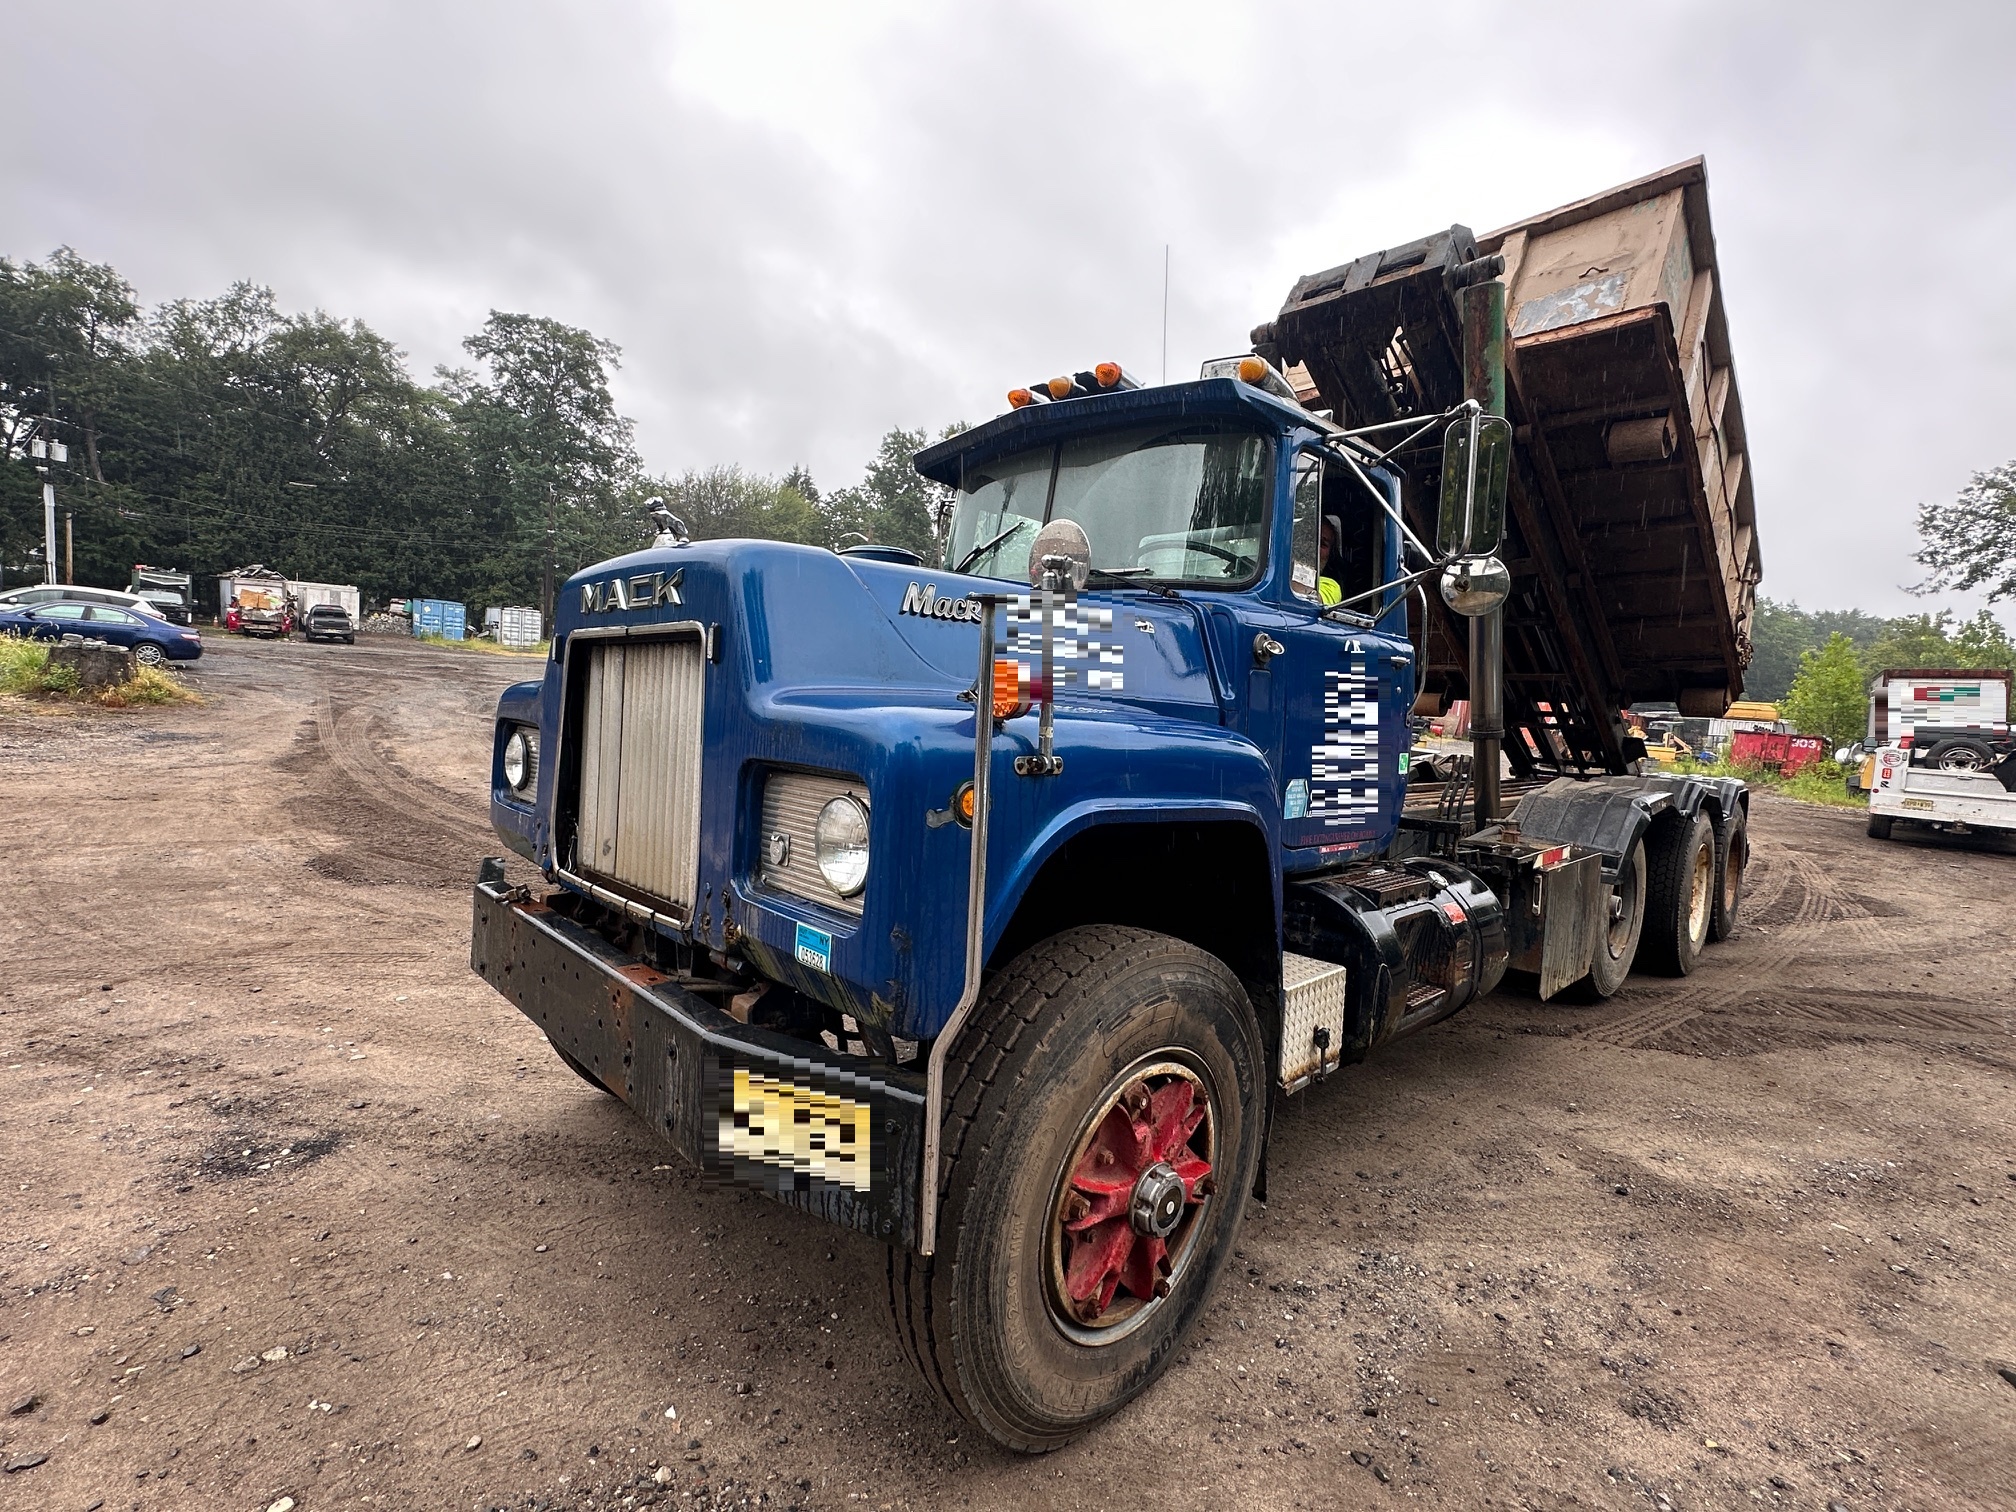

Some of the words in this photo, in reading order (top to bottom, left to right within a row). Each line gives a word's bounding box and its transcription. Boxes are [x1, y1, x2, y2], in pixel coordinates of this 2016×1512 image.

[581, 567, 685, 614] MACK
[900, 582, 982, 623] Mack
[820, 935, 830, 946] NY
[801, 947, 824, 969] 053628
